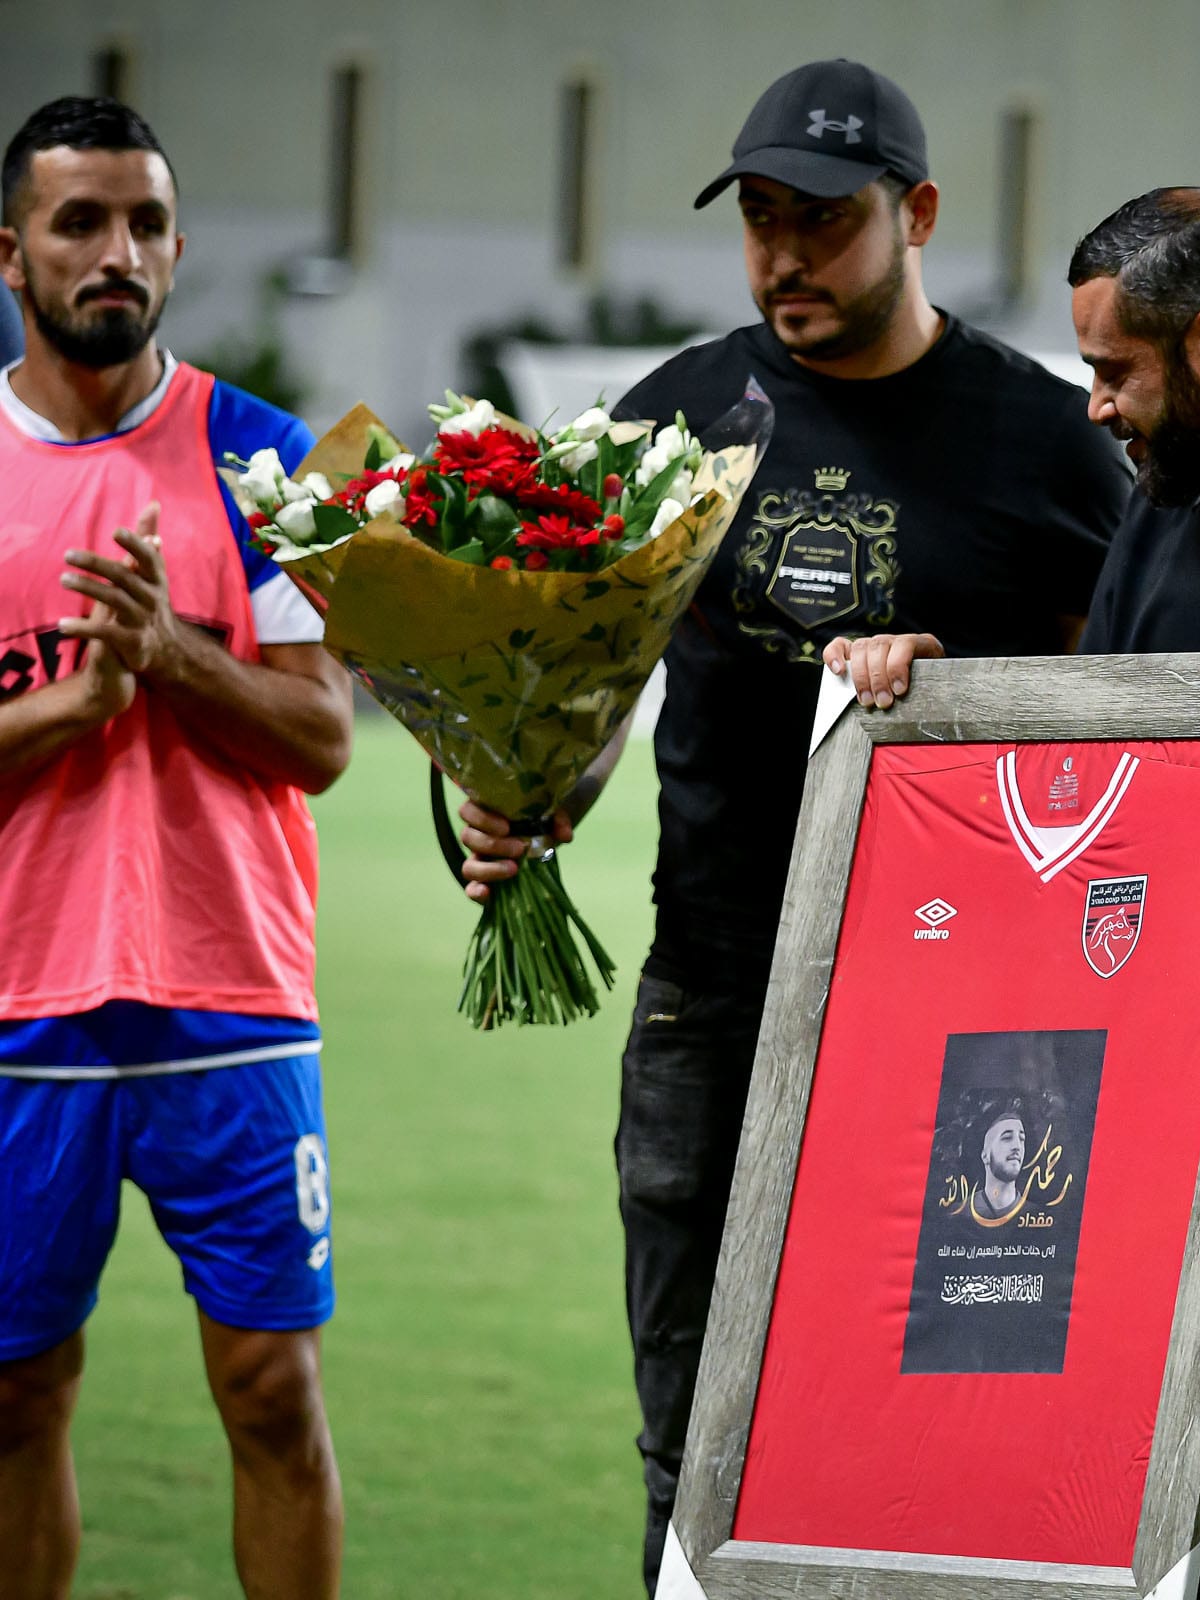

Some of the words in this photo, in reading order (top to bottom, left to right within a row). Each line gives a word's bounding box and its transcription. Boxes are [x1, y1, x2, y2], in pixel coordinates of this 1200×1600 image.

[779, 566, 852, 585] PIERRE
[914, 927, 950, 940] umbro
[294, 1132, 329, 1235] 8
[1018, 1212, 1054, 1228] مقداد
[938, 1245, 951, 1257] الله
[976, 1245, 1003, 1258] والنعيم
[1003, 1245, 1022, 1256] الخلد
[1022, 1245, 1041, 1256] جنات
